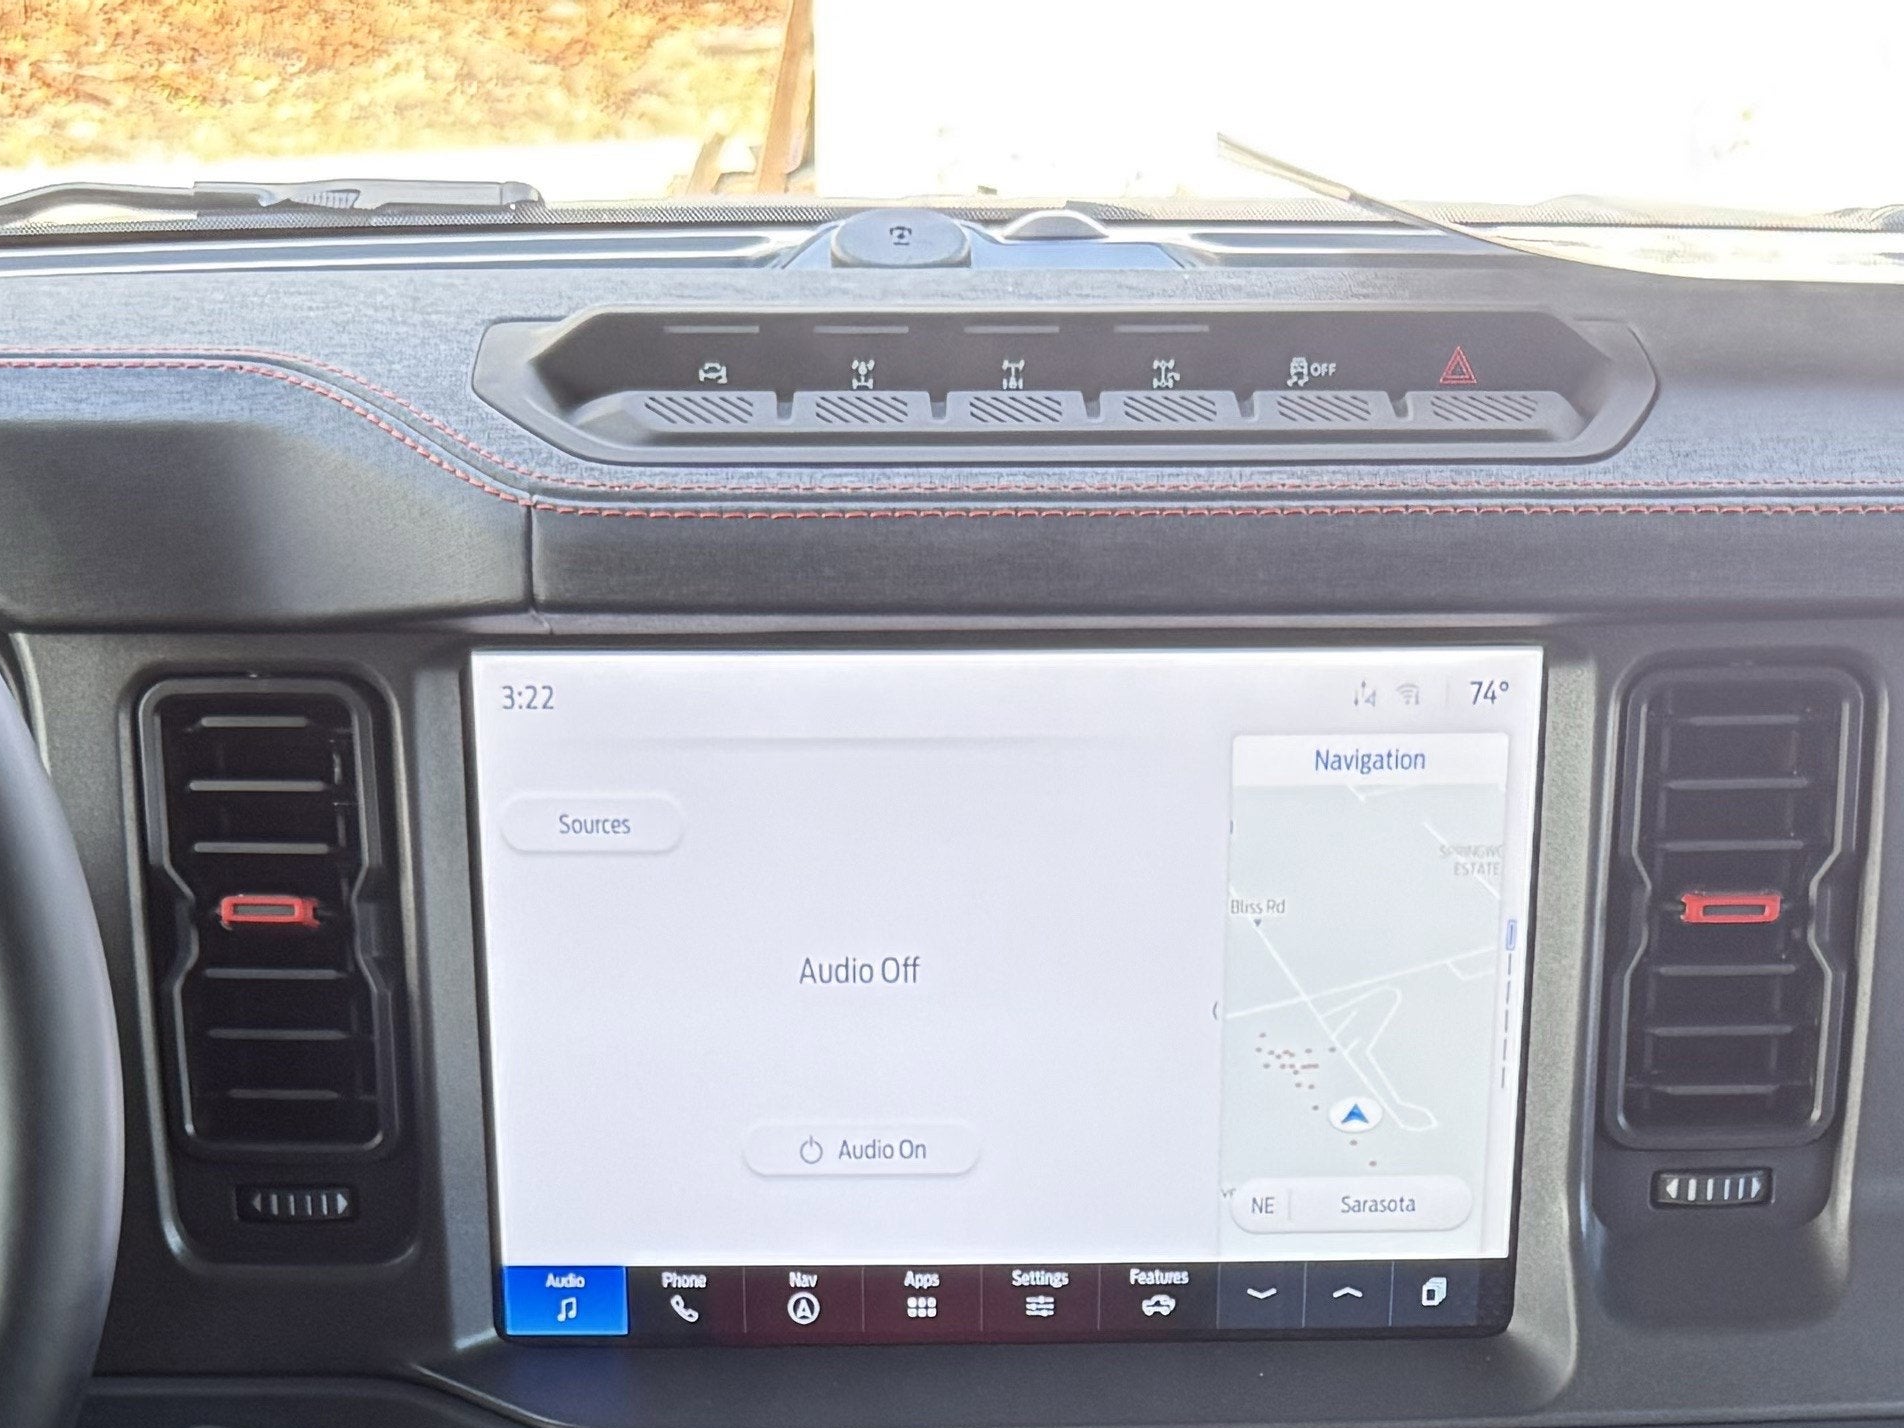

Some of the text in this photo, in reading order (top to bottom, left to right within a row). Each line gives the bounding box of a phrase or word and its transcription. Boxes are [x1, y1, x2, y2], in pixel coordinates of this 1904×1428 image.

[1311, 363, 1335, 376] OFF
[500, 684, 555, 710] 3:22
[1469, 679, 1510, 706] 74°
[1314, 748, 1427, 775] Navigation
[558, 813, 631, 836] Sources
[1266, 899, 1286, 915] Rd
[798, 956, 922, 985] Audio Off
[838, 1138, 928, 1161] Audio On
[1250, 1196, 1275, 1214] NE
[1340, 1196, 1416, 1214] Sarasota
[545, 1272, 586, 1289] Audio
[661, 1272, 708, 1289] Phone
[789, 1272, 818, 1288] Nav
[903, 1271, 941, 1289] Apps
[1011, 1269, 1070, 1289] Settings
[1129, 1268, 1189, 1287] Features
